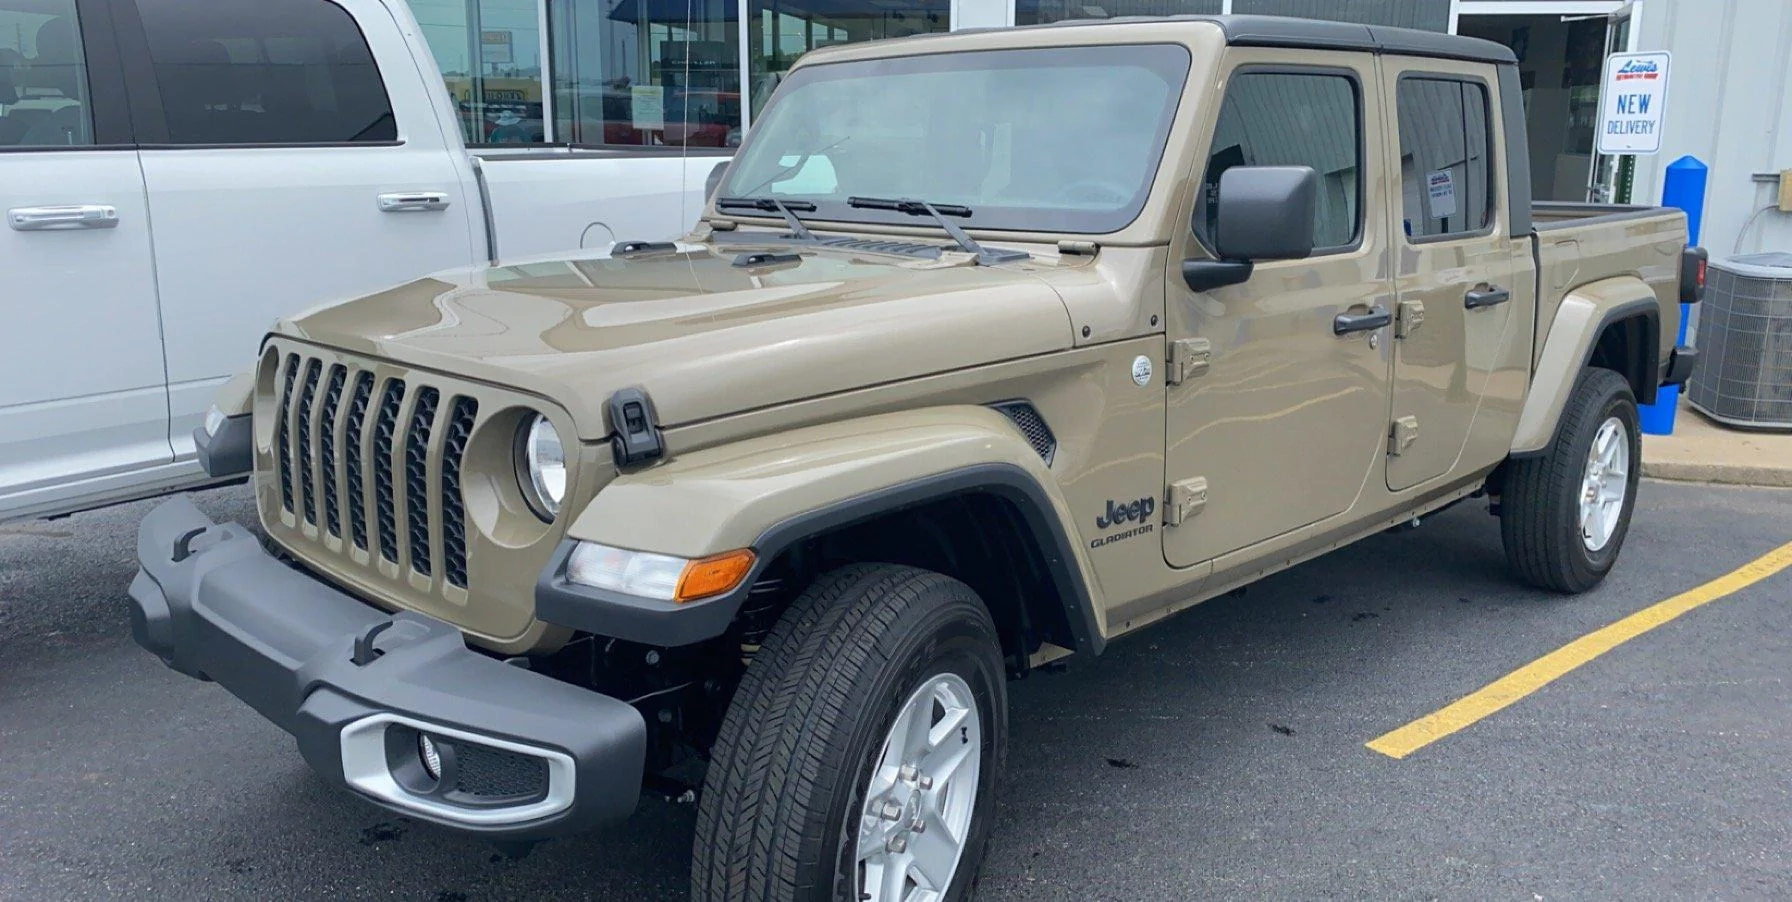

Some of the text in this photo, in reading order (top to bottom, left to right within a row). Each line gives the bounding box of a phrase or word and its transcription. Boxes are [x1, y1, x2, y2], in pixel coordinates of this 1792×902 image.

[1617, 59, 1658, 74] Lewis
[1616, 94, 1651, 114] NEW
[1607, 120, 1656, 135] DELIVERY
[1096, 496, 1155, 529] Jeep
[1090, 524, 1154, 549] GLADIATOR
